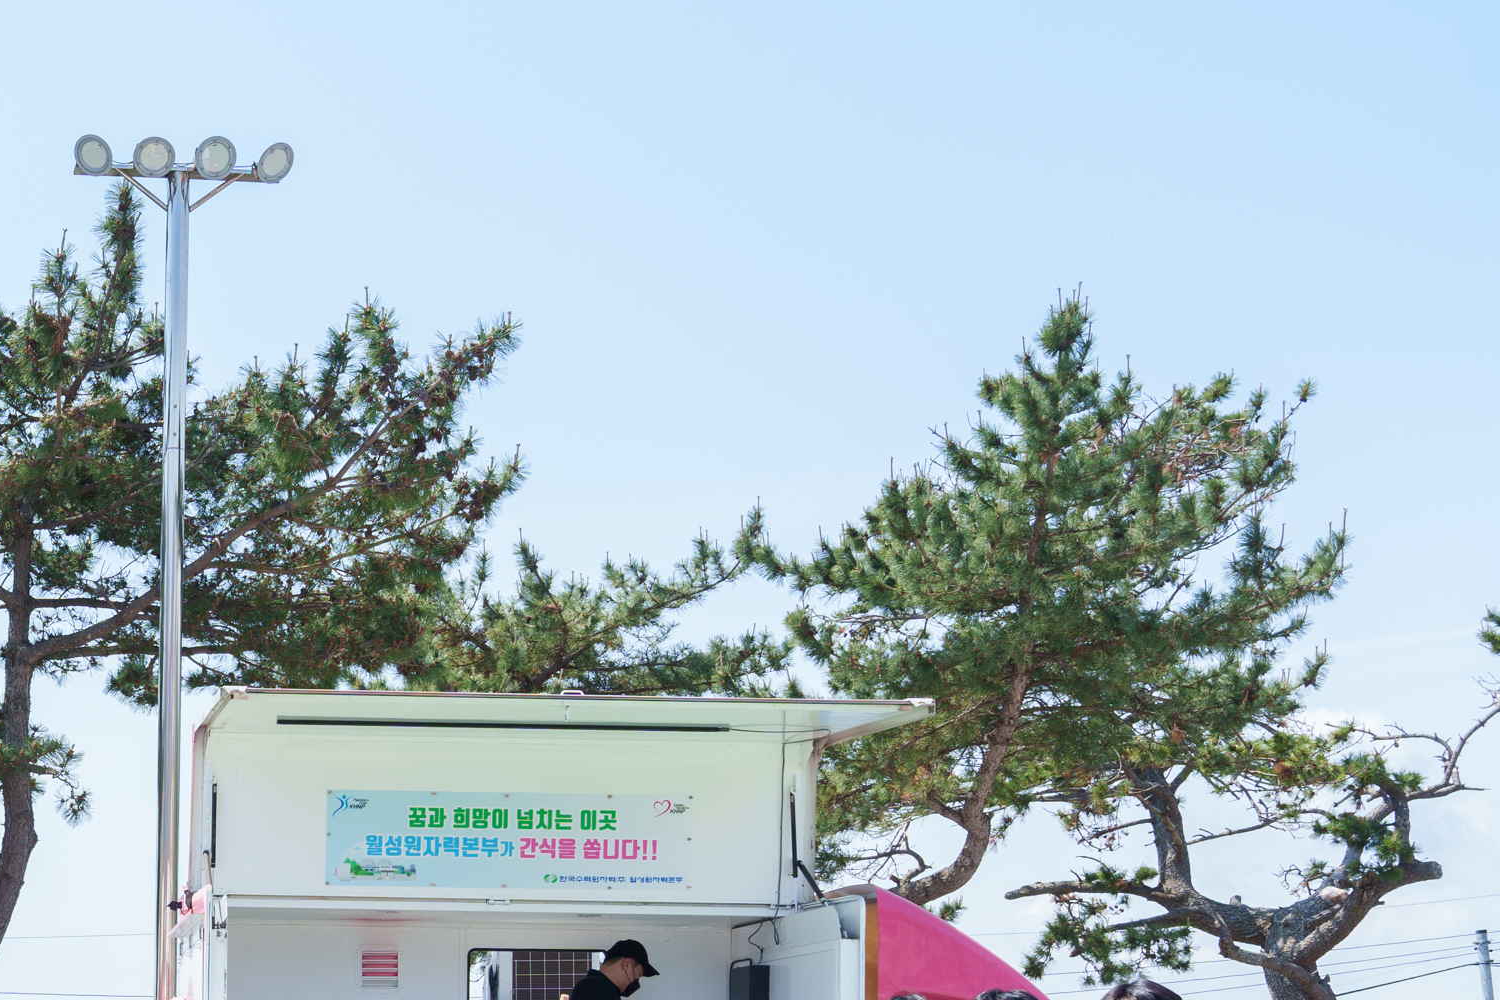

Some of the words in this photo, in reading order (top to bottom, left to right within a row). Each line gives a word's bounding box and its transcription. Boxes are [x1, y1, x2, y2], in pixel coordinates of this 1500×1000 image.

[408, 806, 447, 829] 꿈과
[453, 807, 509, 830] 희망이
[516, 808, 573, 831] 넘치는
[580, 809, 617, 831] 이곳
[365, 834, 515, 858] 월성원자력본부가
[519, 837, 577, 860] 간식을
[583, 838, 658, 861] 쏩니다!!
